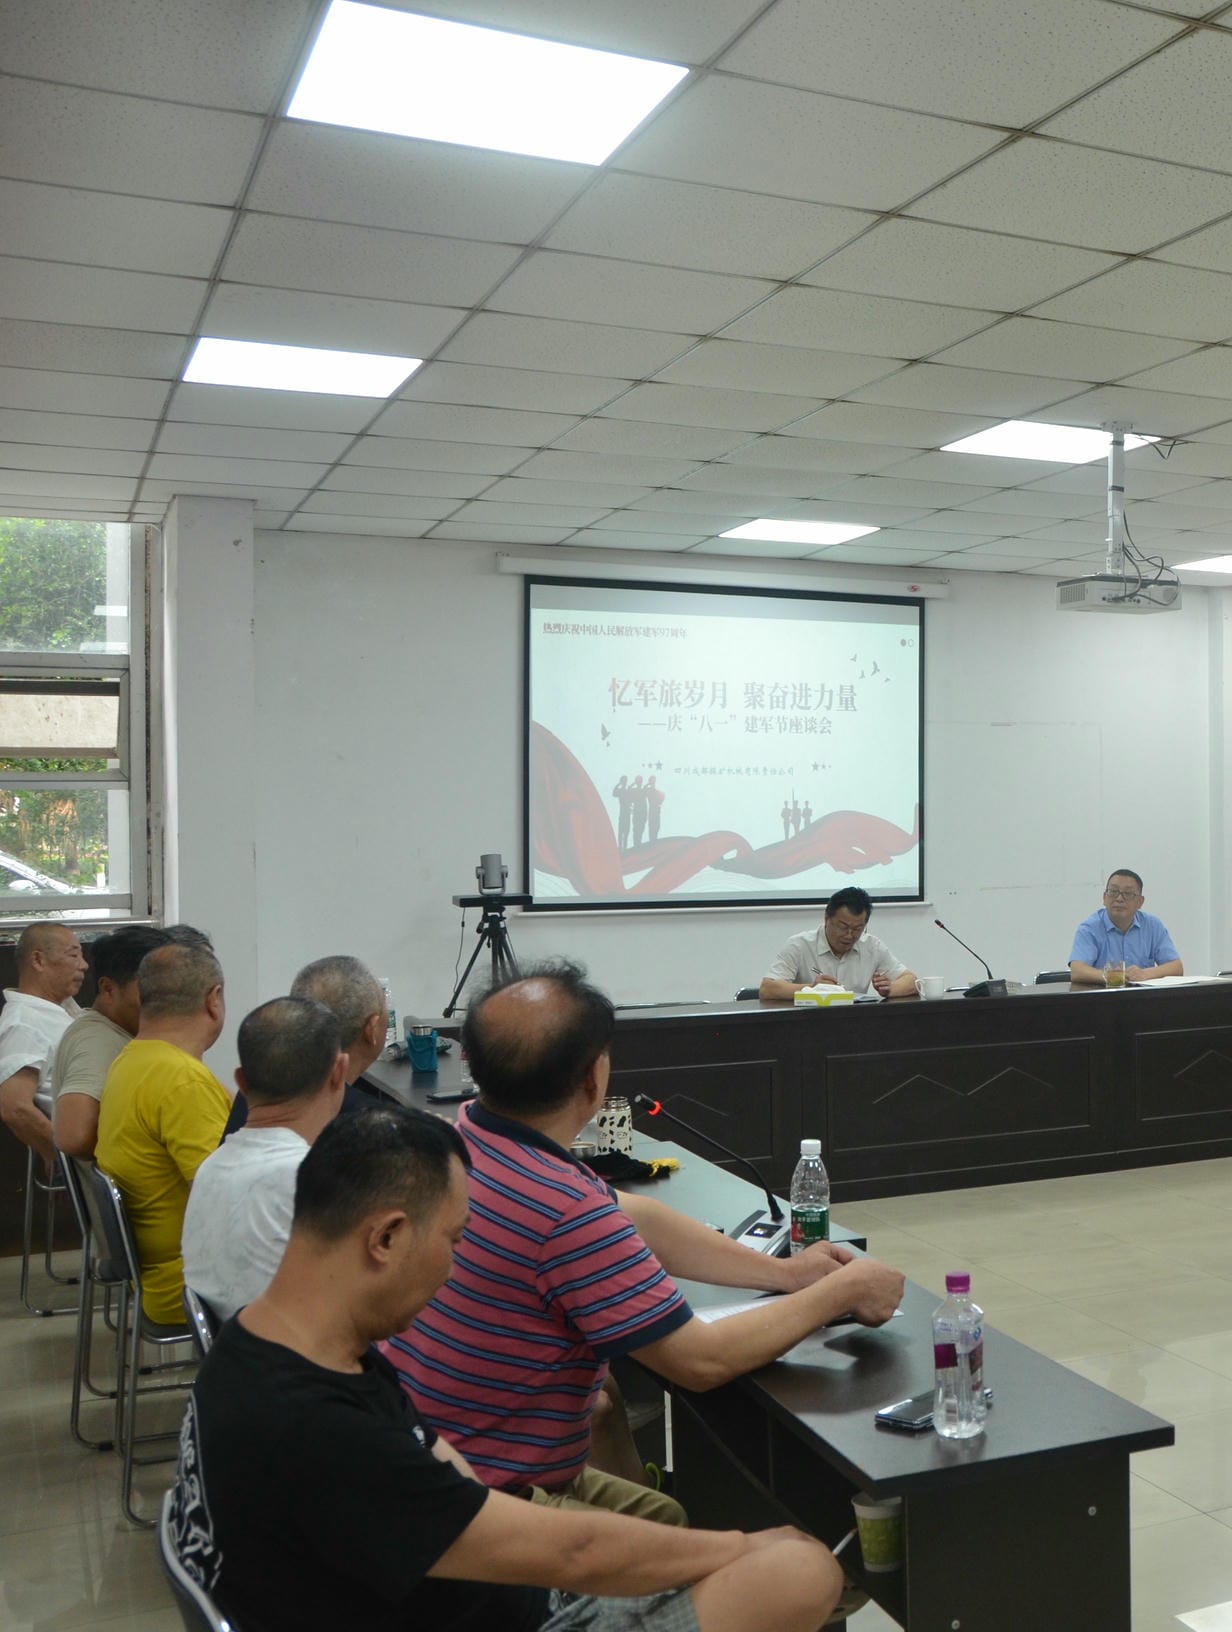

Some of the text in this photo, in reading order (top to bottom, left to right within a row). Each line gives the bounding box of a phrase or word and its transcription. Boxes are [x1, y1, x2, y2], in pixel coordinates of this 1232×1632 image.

[608, 677, 858, 712] 忆军旅岁月 聚奋进力量
